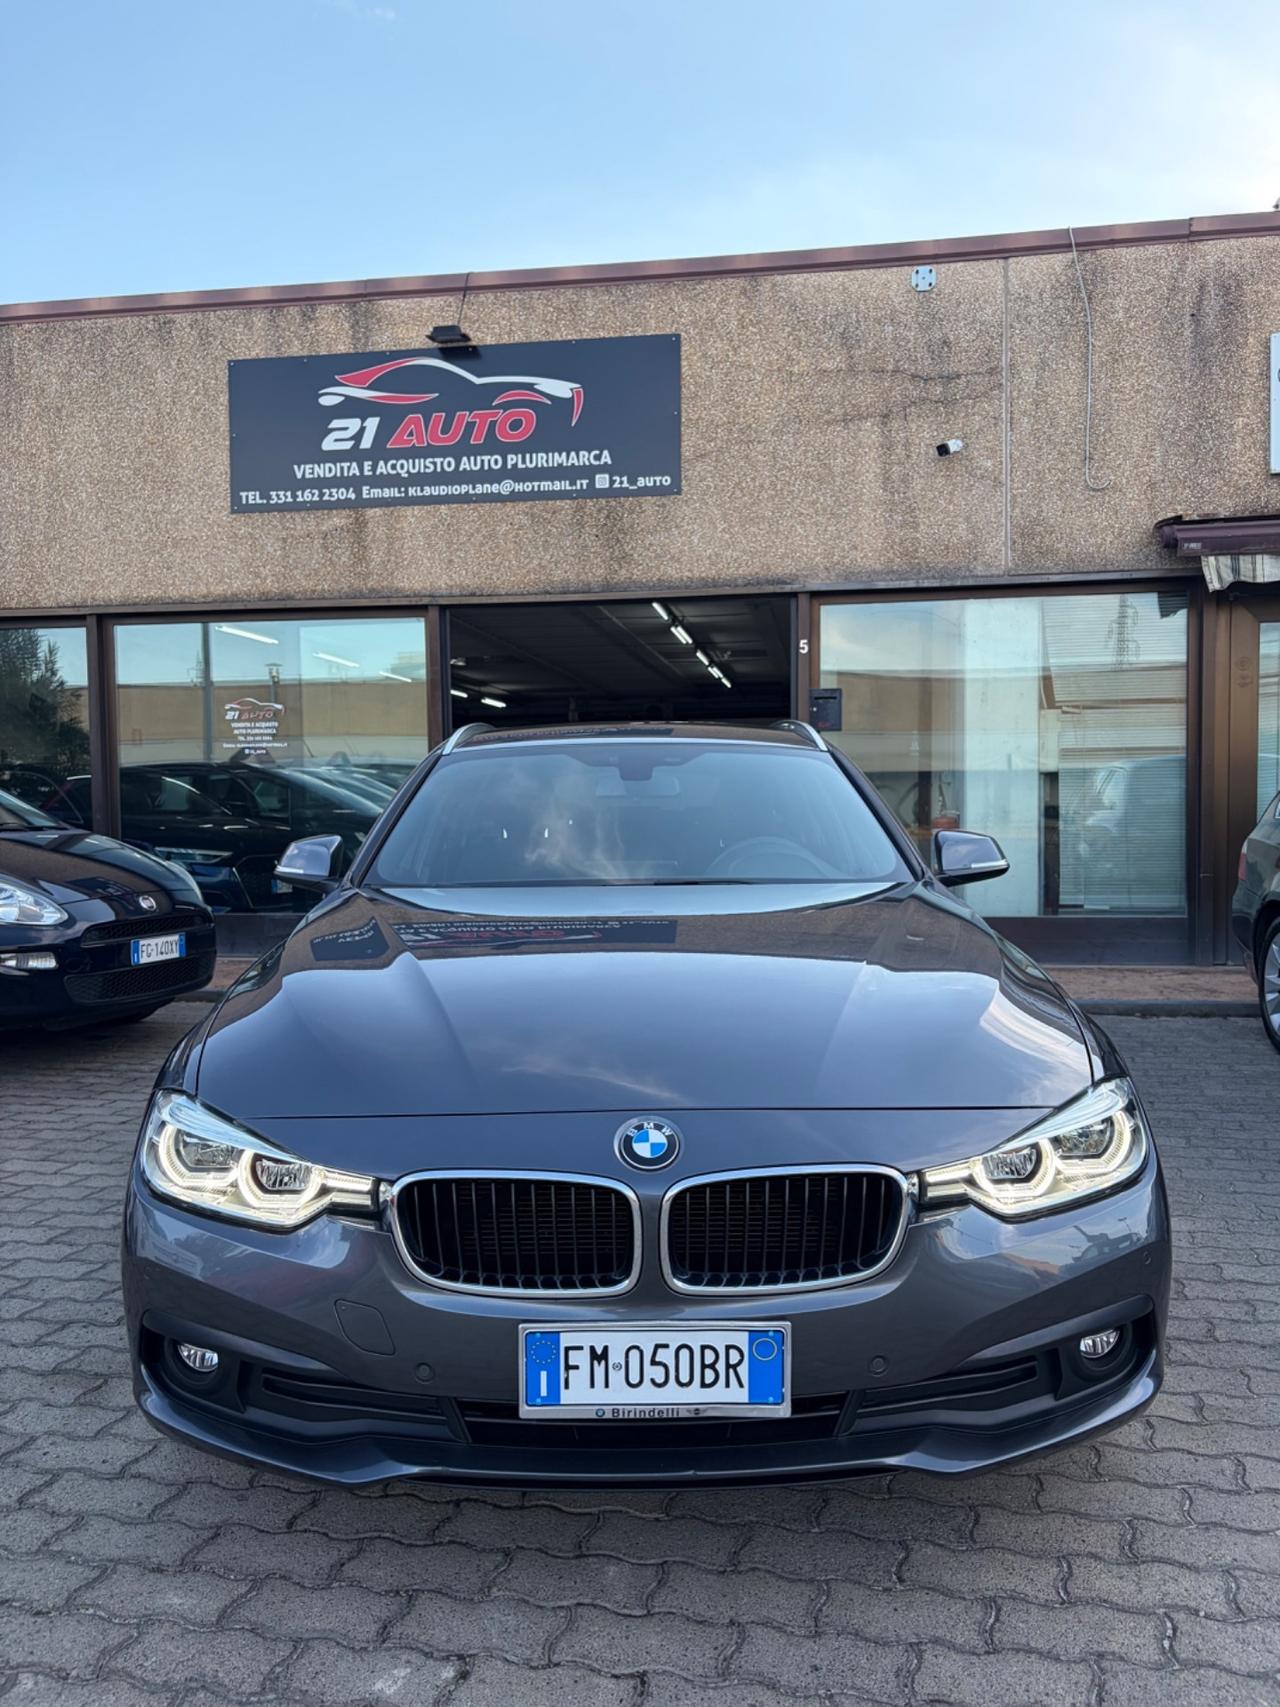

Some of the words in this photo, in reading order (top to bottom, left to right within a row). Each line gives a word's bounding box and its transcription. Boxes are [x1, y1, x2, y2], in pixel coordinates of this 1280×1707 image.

[321, 416, 381, 451] 21
[386, 408, 537, 449] AUTO
[293, 461, 360, 479] VENDITA
[363, 460, 372, 476] E
[376, 457, 456, 478] ACQUISTO
[459, 454, 503, 472] AUTO
[507, 449, 612, 470] PLURIMARCA
[240, 491, 267, 504] TEL.
[269, 490, 293, 504] 331
[296, 489, 320, 502] 162
[322, 487, 356, 501] 2304
[799, 639, 809, 654] 5
[611, 1407, 680, 1419] Birindelli
